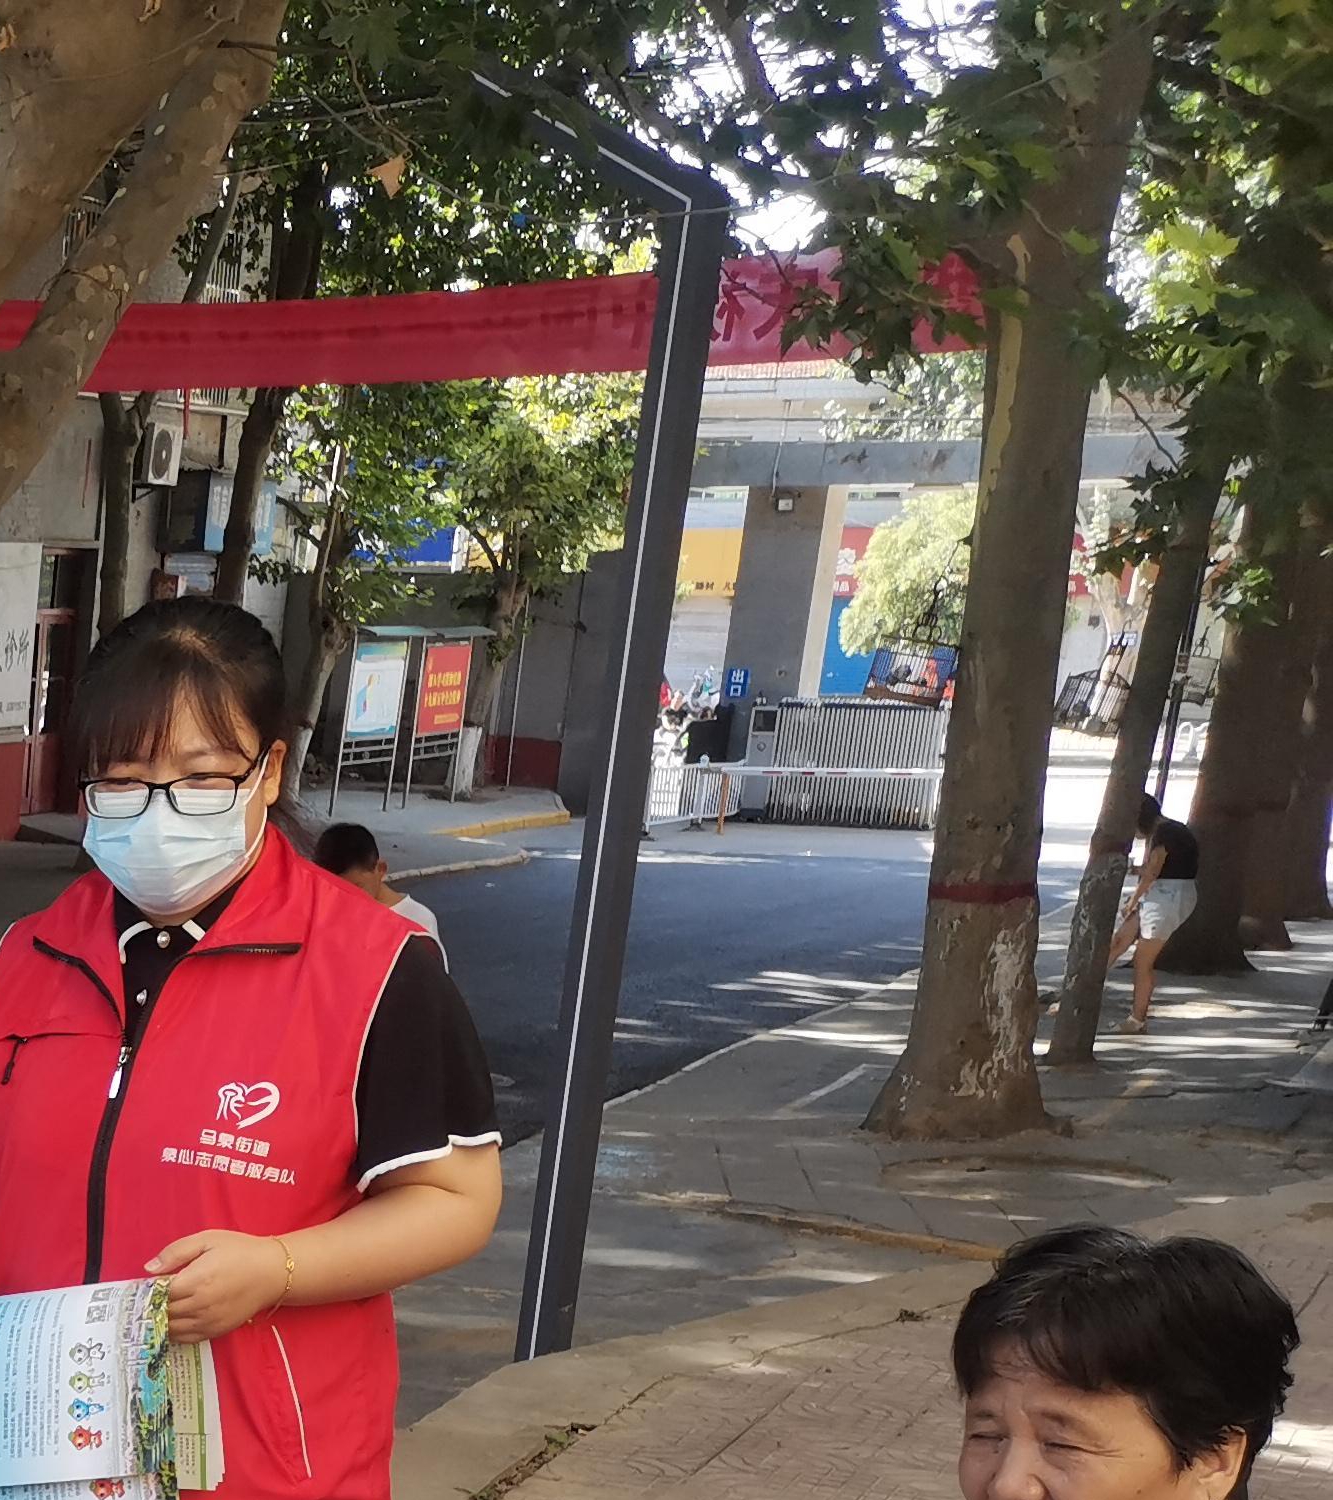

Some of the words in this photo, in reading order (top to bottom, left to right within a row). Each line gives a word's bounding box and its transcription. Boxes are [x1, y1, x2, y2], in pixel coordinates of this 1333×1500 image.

[731, 668, 745, 697] 出口
[160, 1147, 296, 1185] 泉心志愿者服务队
